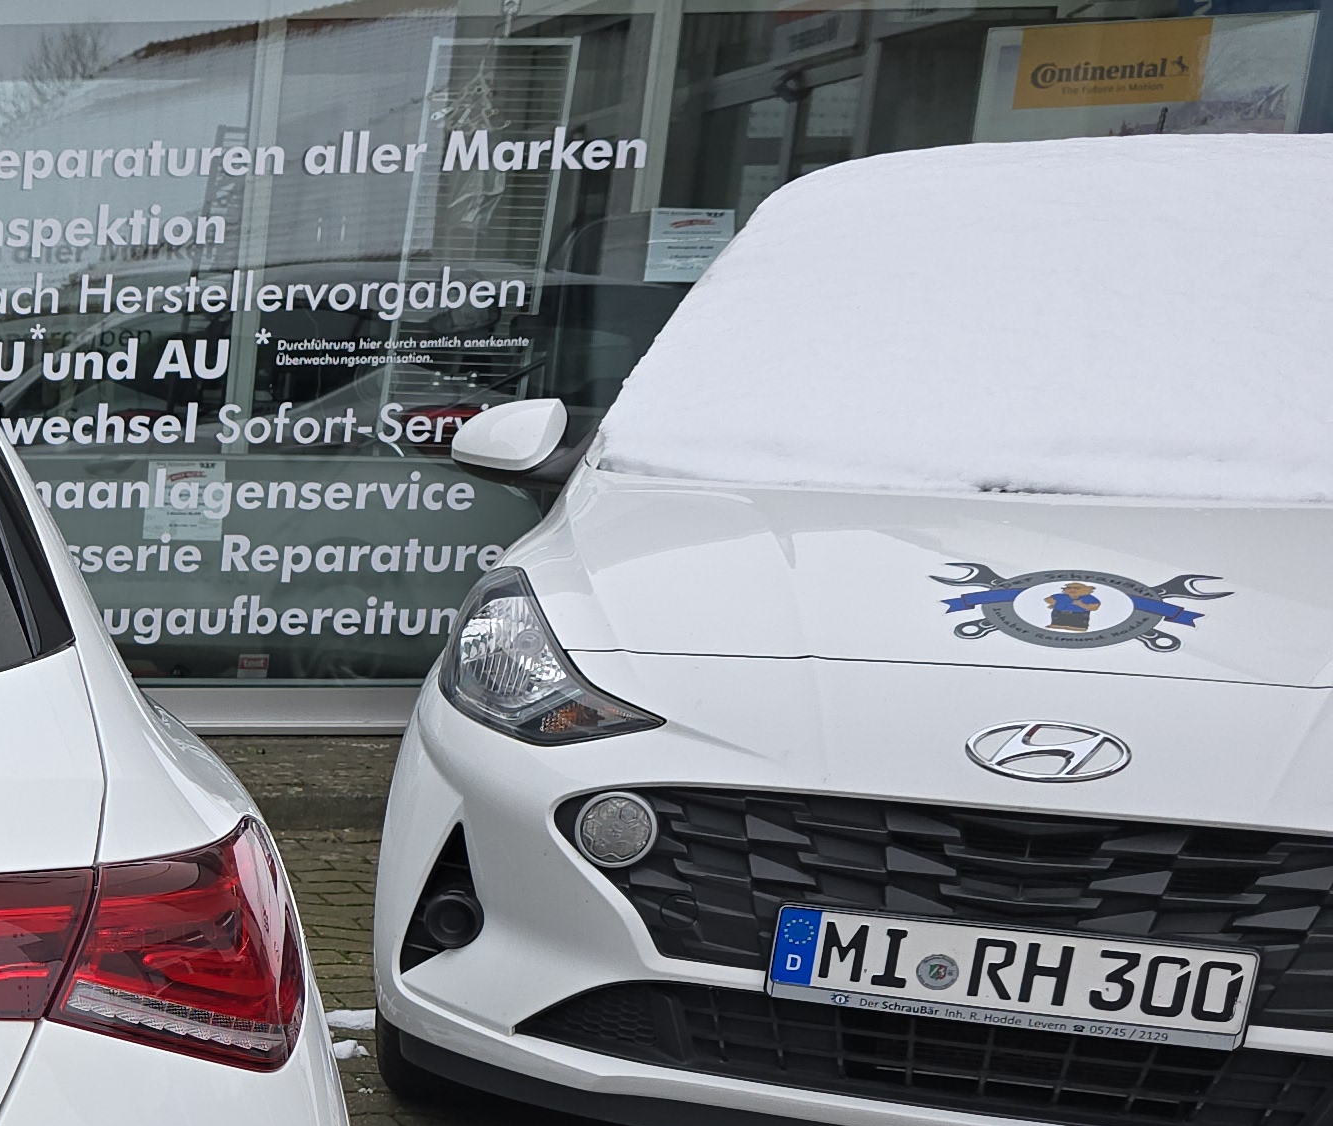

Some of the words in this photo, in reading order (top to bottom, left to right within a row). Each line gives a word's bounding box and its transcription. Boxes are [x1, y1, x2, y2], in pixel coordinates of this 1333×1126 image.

[1031, 56, 1168, 89] Continental
[1128, 82, 1164, 92] Motion
[304, 131, 428, 175] aller
[442, 126, 648, 172] Marken
[79, 266, 526, 320] Herstellervorgaben
[42, 338, 138, 380] und
[153, 339, 231, 380] AU
[276, 352, 434, 368] Überwachungsorganisation.
[277, 338, 356, 351] Durchführung
[358, 337, 382, 350] hier
[384, 337, 417, 349] durch
[419, 336, 461, 348] amtlich
[463, 336, 530, 348] anerkannte
[216, 402, 490, 444] Sofort-Ser
[221, 534, 506, 583] Reparature
[102, 595, 459, 645] ugaufbereitun
[786, 954, 801, 971] D
[818, 921, 908, 988] MI
[966, 937, 1076, 1007] RH
[1089, 949, 1244, 1023] 300
[860, 998, 879, 1008] Der
[881, 999, 940, 1016] SchrauBär
[944, 1008, 966, 1020] Inh.
[970, 1011, 981, 1021] R.
[984, 1013, 1022, 1027] Hodde
[1028, 1018, 1067, 1031] Levern
[1089, 1025, 1126, 1038] 05745
[1139, 1030, 1169, 1042] 2129
